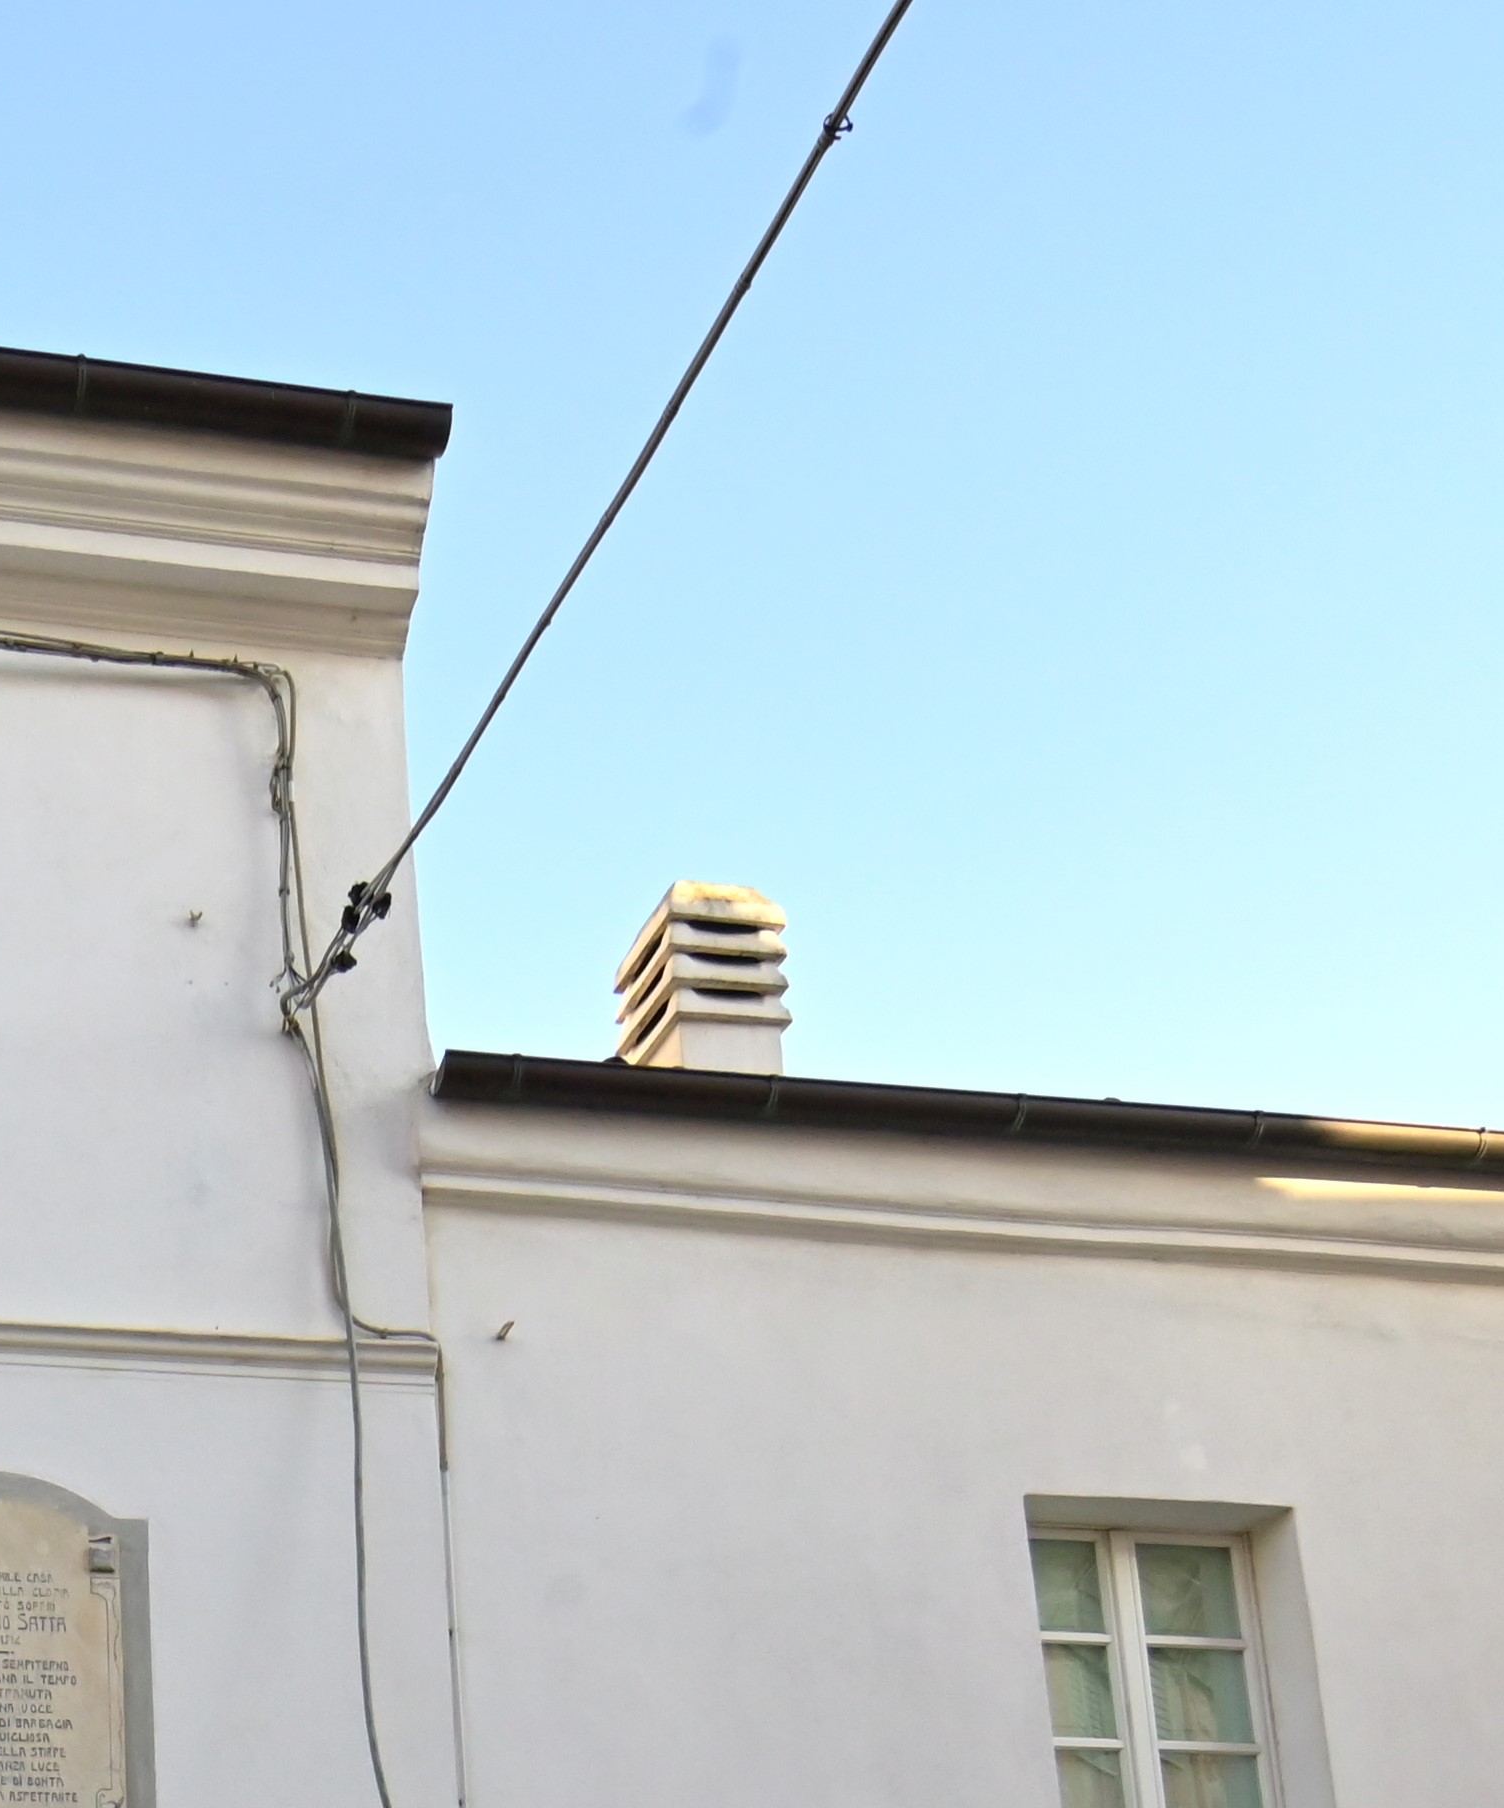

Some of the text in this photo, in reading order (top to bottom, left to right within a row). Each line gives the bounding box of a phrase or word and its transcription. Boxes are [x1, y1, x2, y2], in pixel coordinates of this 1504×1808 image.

[27, 1572, 54, 1583] CASA
[17, 1612, 67, 1633] SATTA
[1, 1658, 69, 1671] SEMPITERNO
[23, 1674, 34, 1685] IL
[40, 1674, 77, 1686] TEMPO
[15, 1718, 73, 1731] BARBAGIA
[30, 1747, 67, 1759] STIRPE
[30, 1761, 60, 1772] LUCE
[0, 1775, 7, 1785] E
[13, 1776, 23, 1786] DI
[9, 1791, 79, 1804] ASPETTANTE
